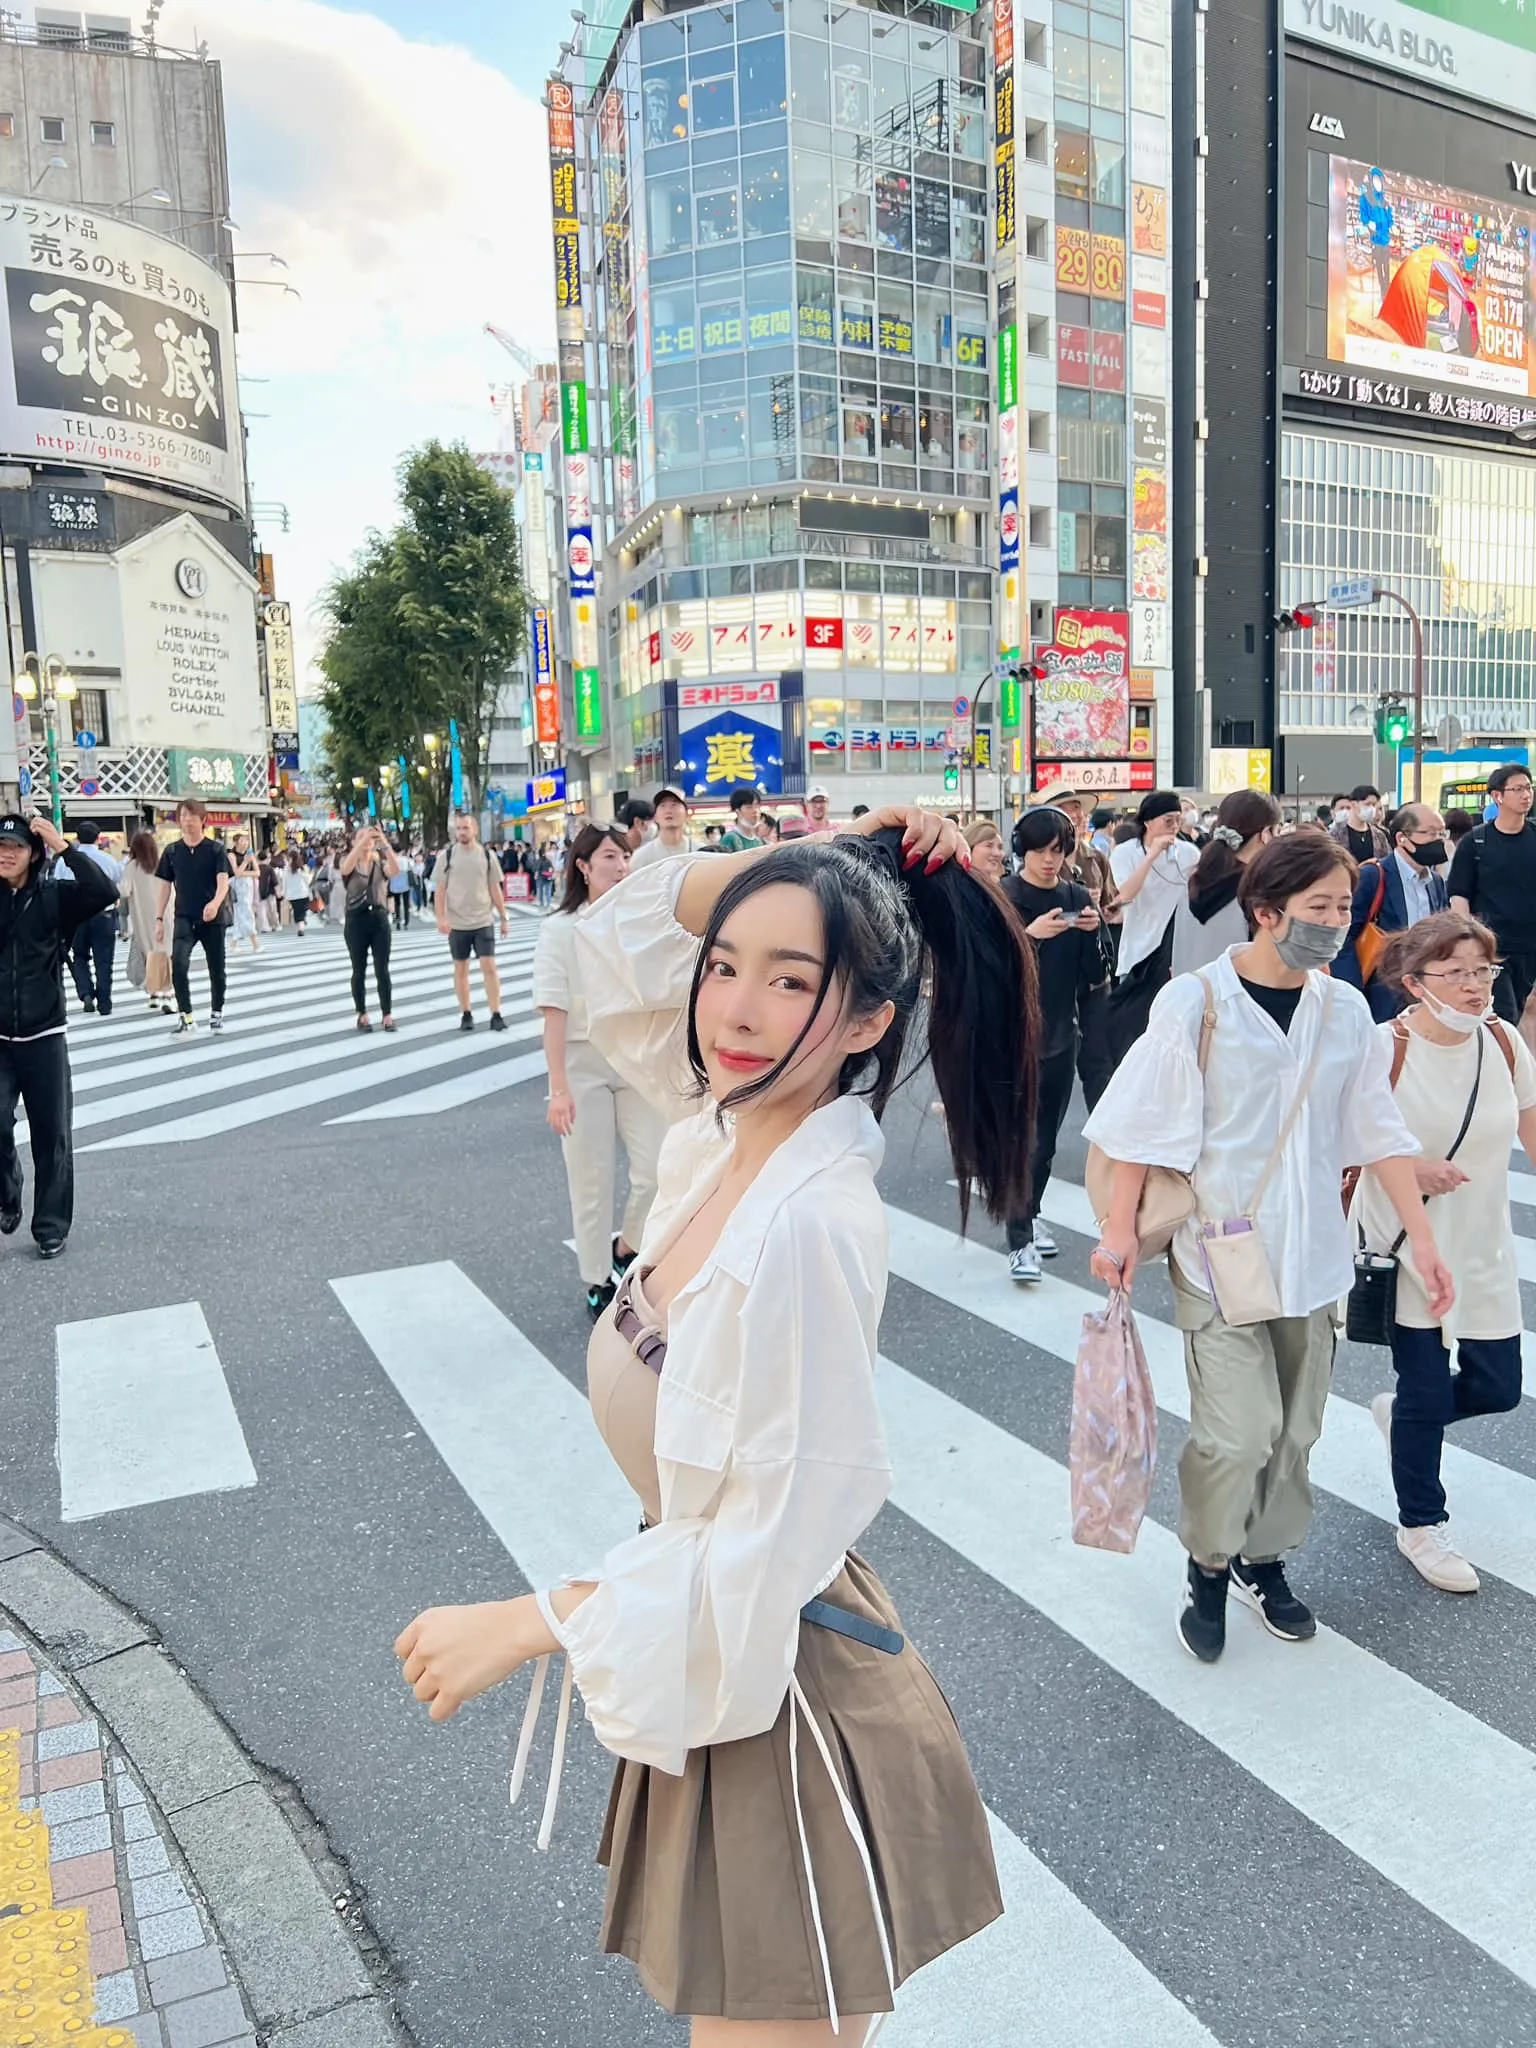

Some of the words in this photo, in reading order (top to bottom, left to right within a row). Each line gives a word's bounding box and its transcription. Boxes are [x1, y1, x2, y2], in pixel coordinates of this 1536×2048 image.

[1300, 0, 1394, 53] YUNIKA
[1399, 29, 1458, 76] BLDG.
[0, 204, 98, 240] ブランド品
[704, 319, 744, 346] 祝日
[749, 309, 792, 338] 夜間
[840, 318, 872, 344] 内科
[957, 336, 984, 363] 6F
[1485, 323, 1523, 361] OPEN
[1060, 348, 1121, 370] FASTNAIL
[713, 623, 797, 646] アイフル
[812, 626, 835, 644] 3F
[888, 625, 955, 643] アイフル
[173, 657, 217, 672] ROLEX
[170, 701, 225, 717] CHANEL
[705, 733, 758, 785] 薬
